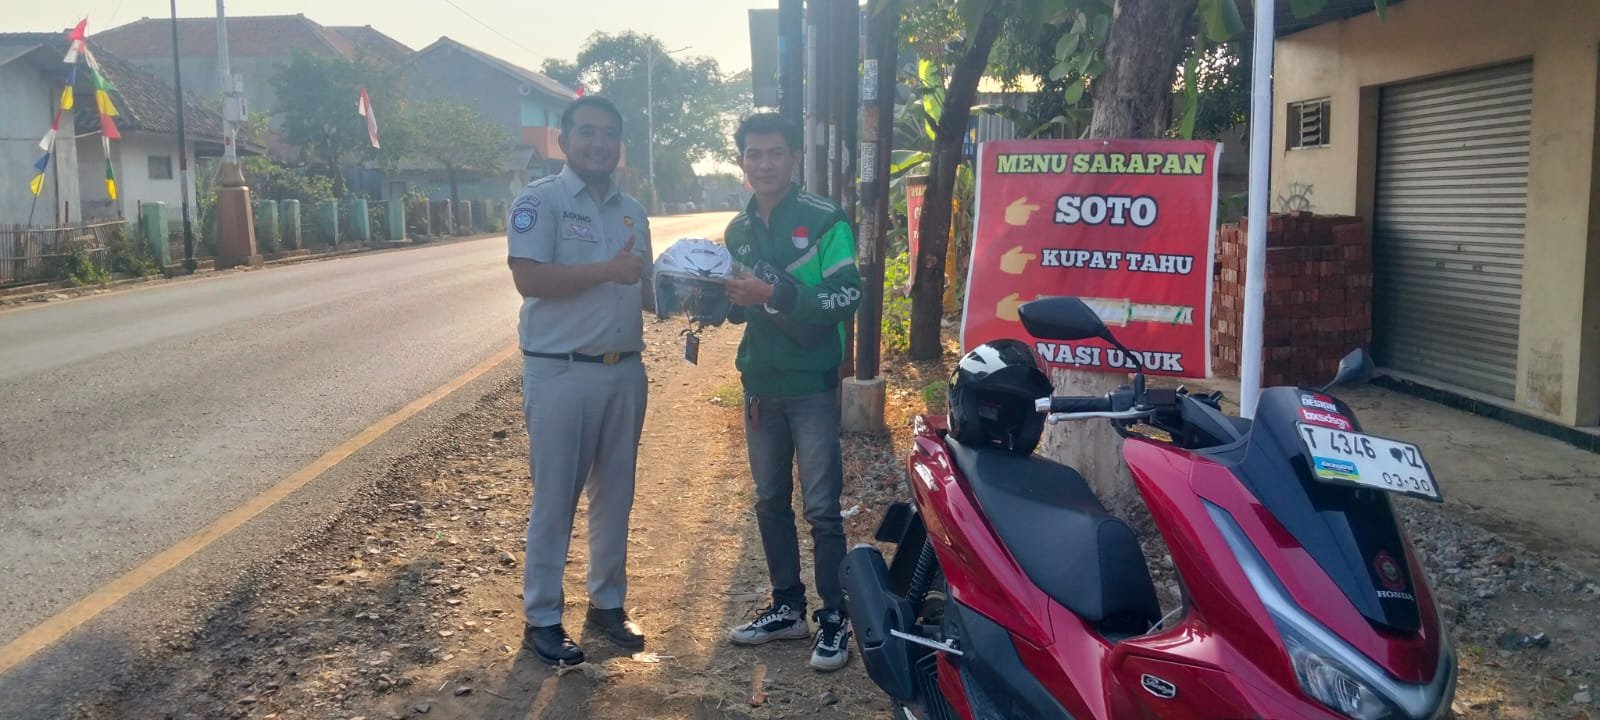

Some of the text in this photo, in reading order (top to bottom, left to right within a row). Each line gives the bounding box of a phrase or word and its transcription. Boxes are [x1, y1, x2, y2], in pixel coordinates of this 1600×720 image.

[997, 154, 1205, 175] MENU SARAPAN
[1054, 195, 1157, 227] SOTO
[1041, 249, 1193, 274] KUPAT TAHU
[817, 286, 860, 309] Grab
[1036, 343, 1101, 366] NASI
[1304, 427, 1317, 449] T
[1330, 431, 1376, 459] 4346
[1376, 590, 1414, 601] HONDA
